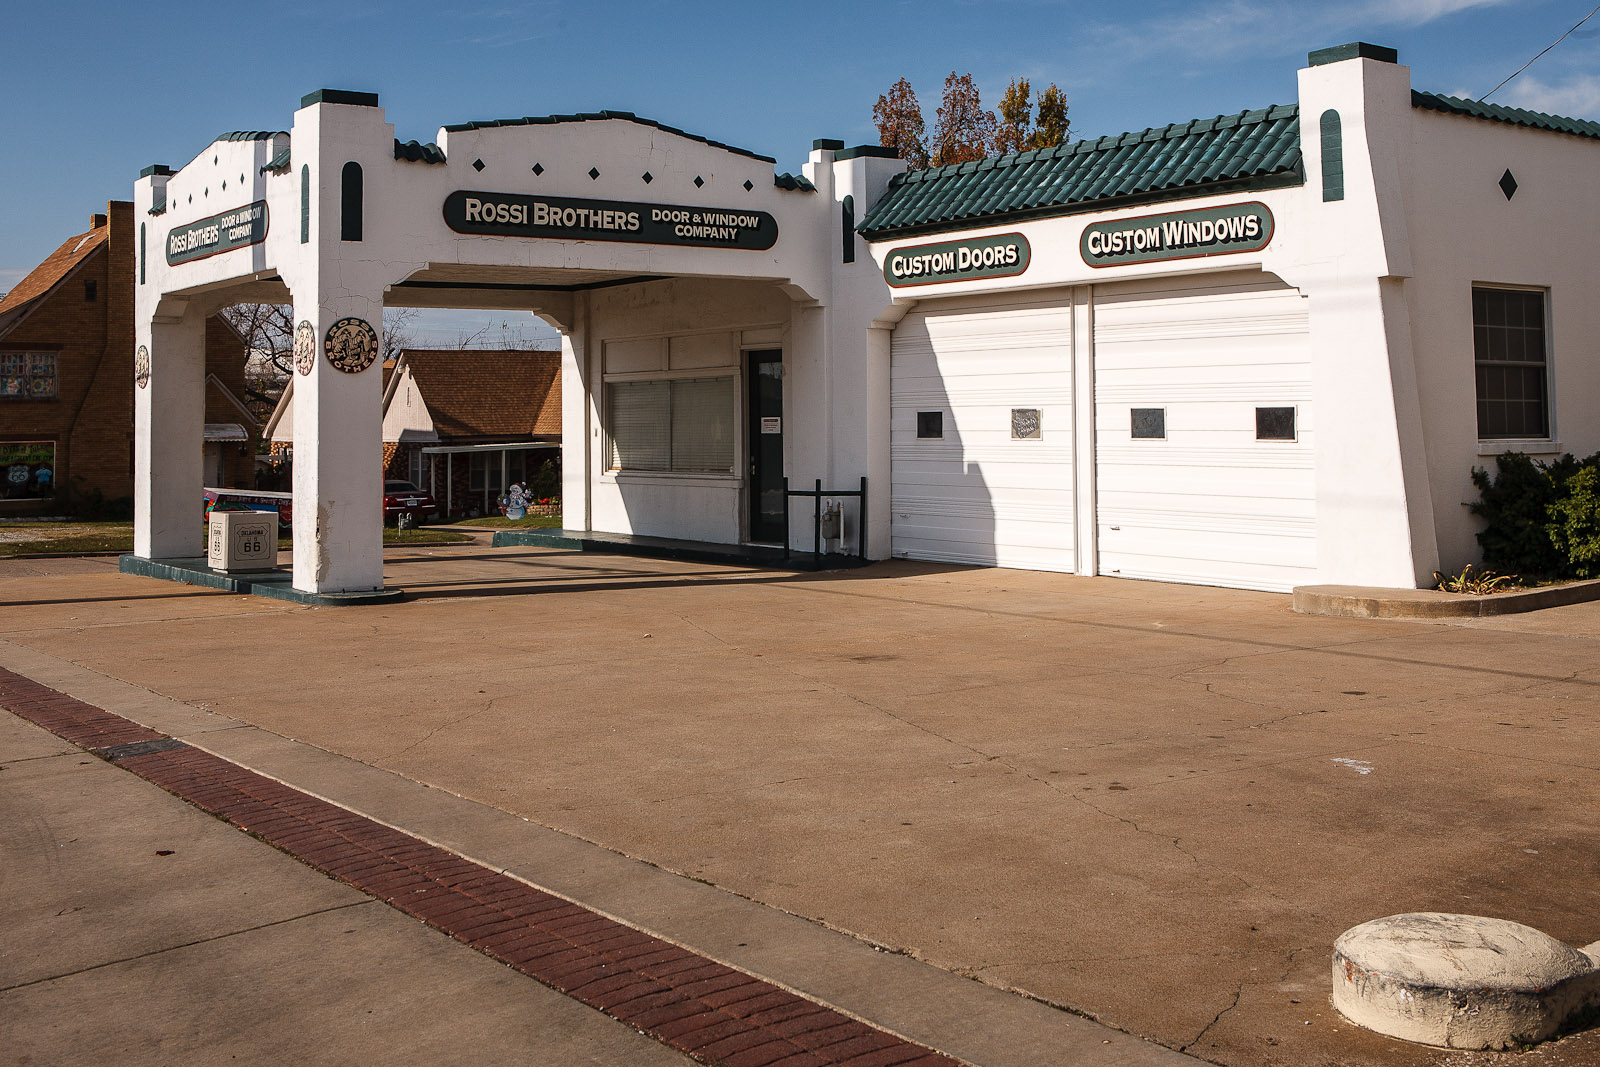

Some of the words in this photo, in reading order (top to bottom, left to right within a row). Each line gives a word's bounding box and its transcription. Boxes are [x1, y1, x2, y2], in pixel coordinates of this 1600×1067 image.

[221, 214, 236, 229] DOOR
[239, 206, 262, 223] WINDOW
[465, 198, 528, 225] ROSSI
[533, 202, 640, 231] BROTHERS
[651, 209, 690, 223] DOOR
[692, 213, 702, 224] &
[702, 212, 759, 228] WINDOW
[170, 234, 187, 255] ROSSI
[187, 224, 219, 250] BROTHERS
[228, 223, 252, 241] COMPANY
[674, 224, 738, 240] COMPANY
[1087, 226, 1161, 255] CUSTOM
[1162, 214, 1260, 247] WINDOWS
[891, 251, 955, 277] CUSTOM
[958, 244, 1019, 270] DOORS
[328, 319, 374, 337] ROSSI
[325, 341, 378, 373] BROTHERS
[244, 541, 261, 553] 66
